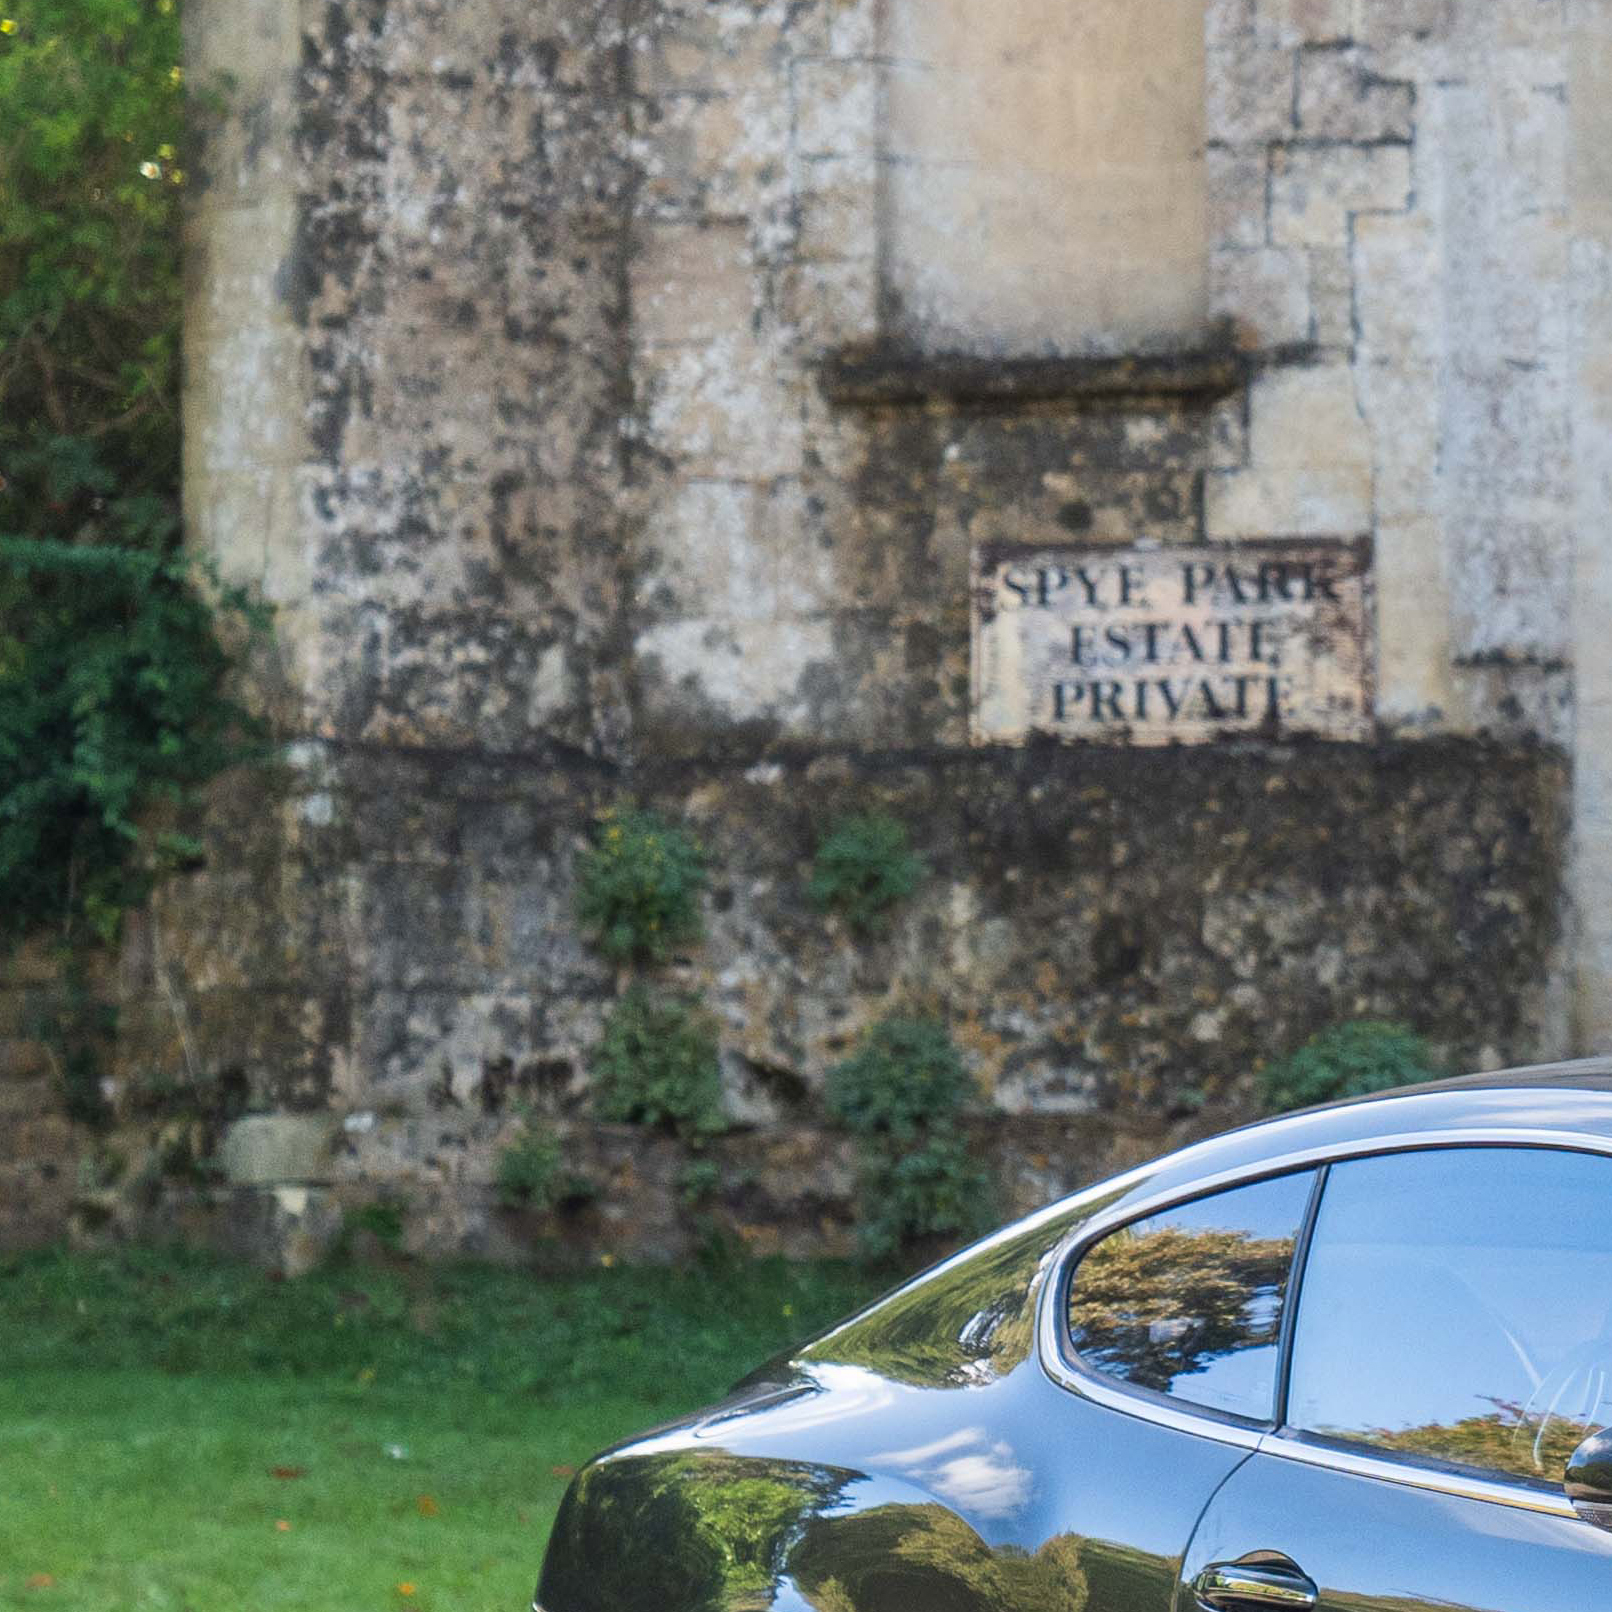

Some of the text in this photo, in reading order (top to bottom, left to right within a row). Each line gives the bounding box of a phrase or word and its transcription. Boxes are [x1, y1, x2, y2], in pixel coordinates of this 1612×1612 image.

[1003, 560, 1342, 607] SPYE PARK
[1070, 619, 1280, 666] ESTATE
[1051, 674, 1297, 723] PRIVATE
